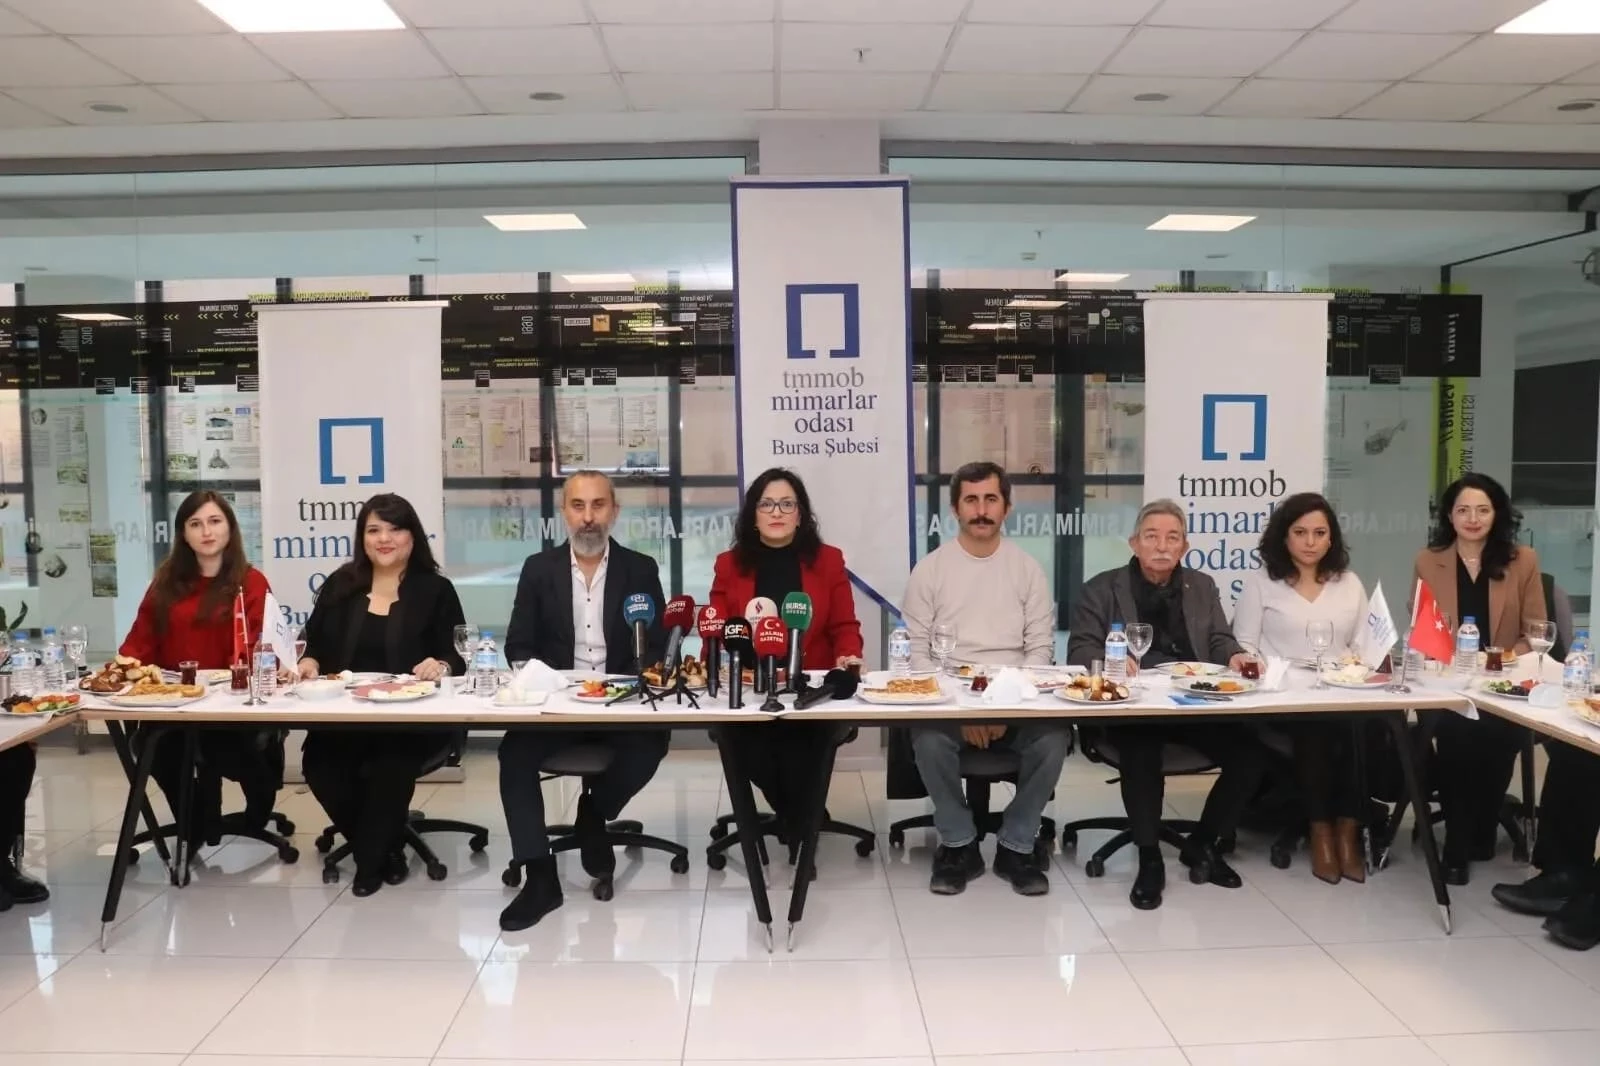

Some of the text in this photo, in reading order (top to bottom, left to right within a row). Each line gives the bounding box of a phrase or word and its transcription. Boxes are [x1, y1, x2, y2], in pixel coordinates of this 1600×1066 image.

[783, 366, 865, 389] tmmob
[771, 389, 878, 411] mimarlar
[794, 411, 854, 433] odası
[772, 436, 879, 458] Bursa Şubesi
[1178, 468, 1287, 497] tmmob
[298, 497, 366, 521] tmm
[1185, 539, 1263, 571] odas
[785, 602, 807, 611] BURSA
